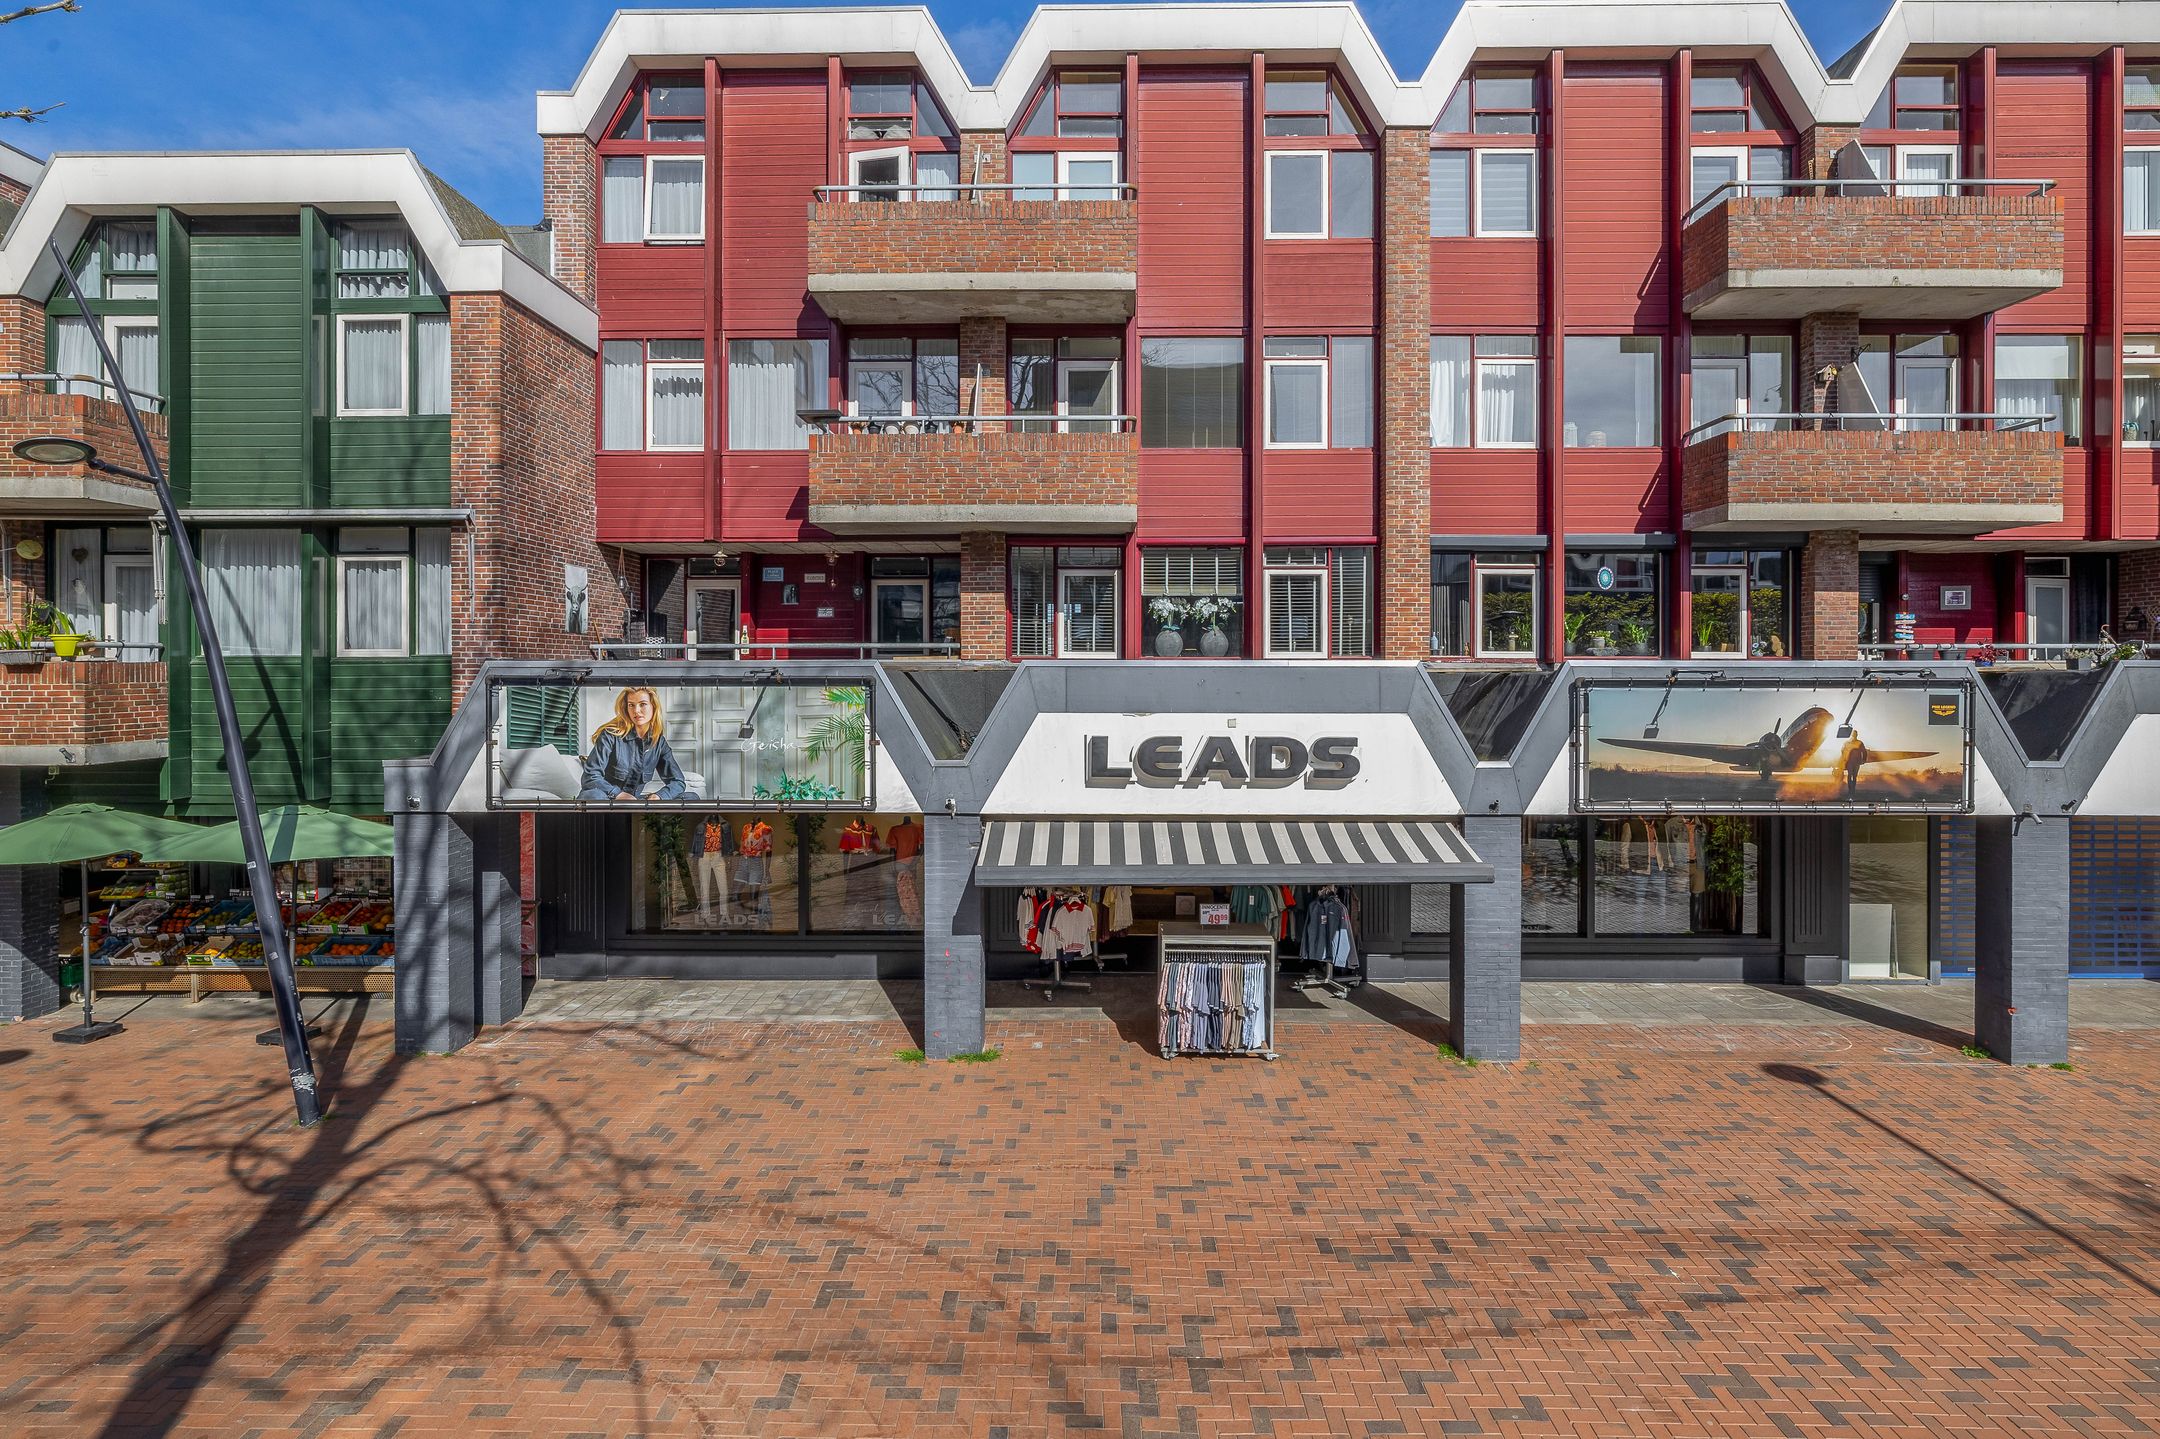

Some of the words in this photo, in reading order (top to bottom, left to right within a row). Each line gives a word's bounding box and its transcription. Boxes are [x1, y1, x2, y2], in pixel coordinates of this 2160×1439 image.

[741, 737, 797, 755] Geisha
[1087, 735, 1361, 786] LEADS
[694, 914, 760, 925] LEADS
